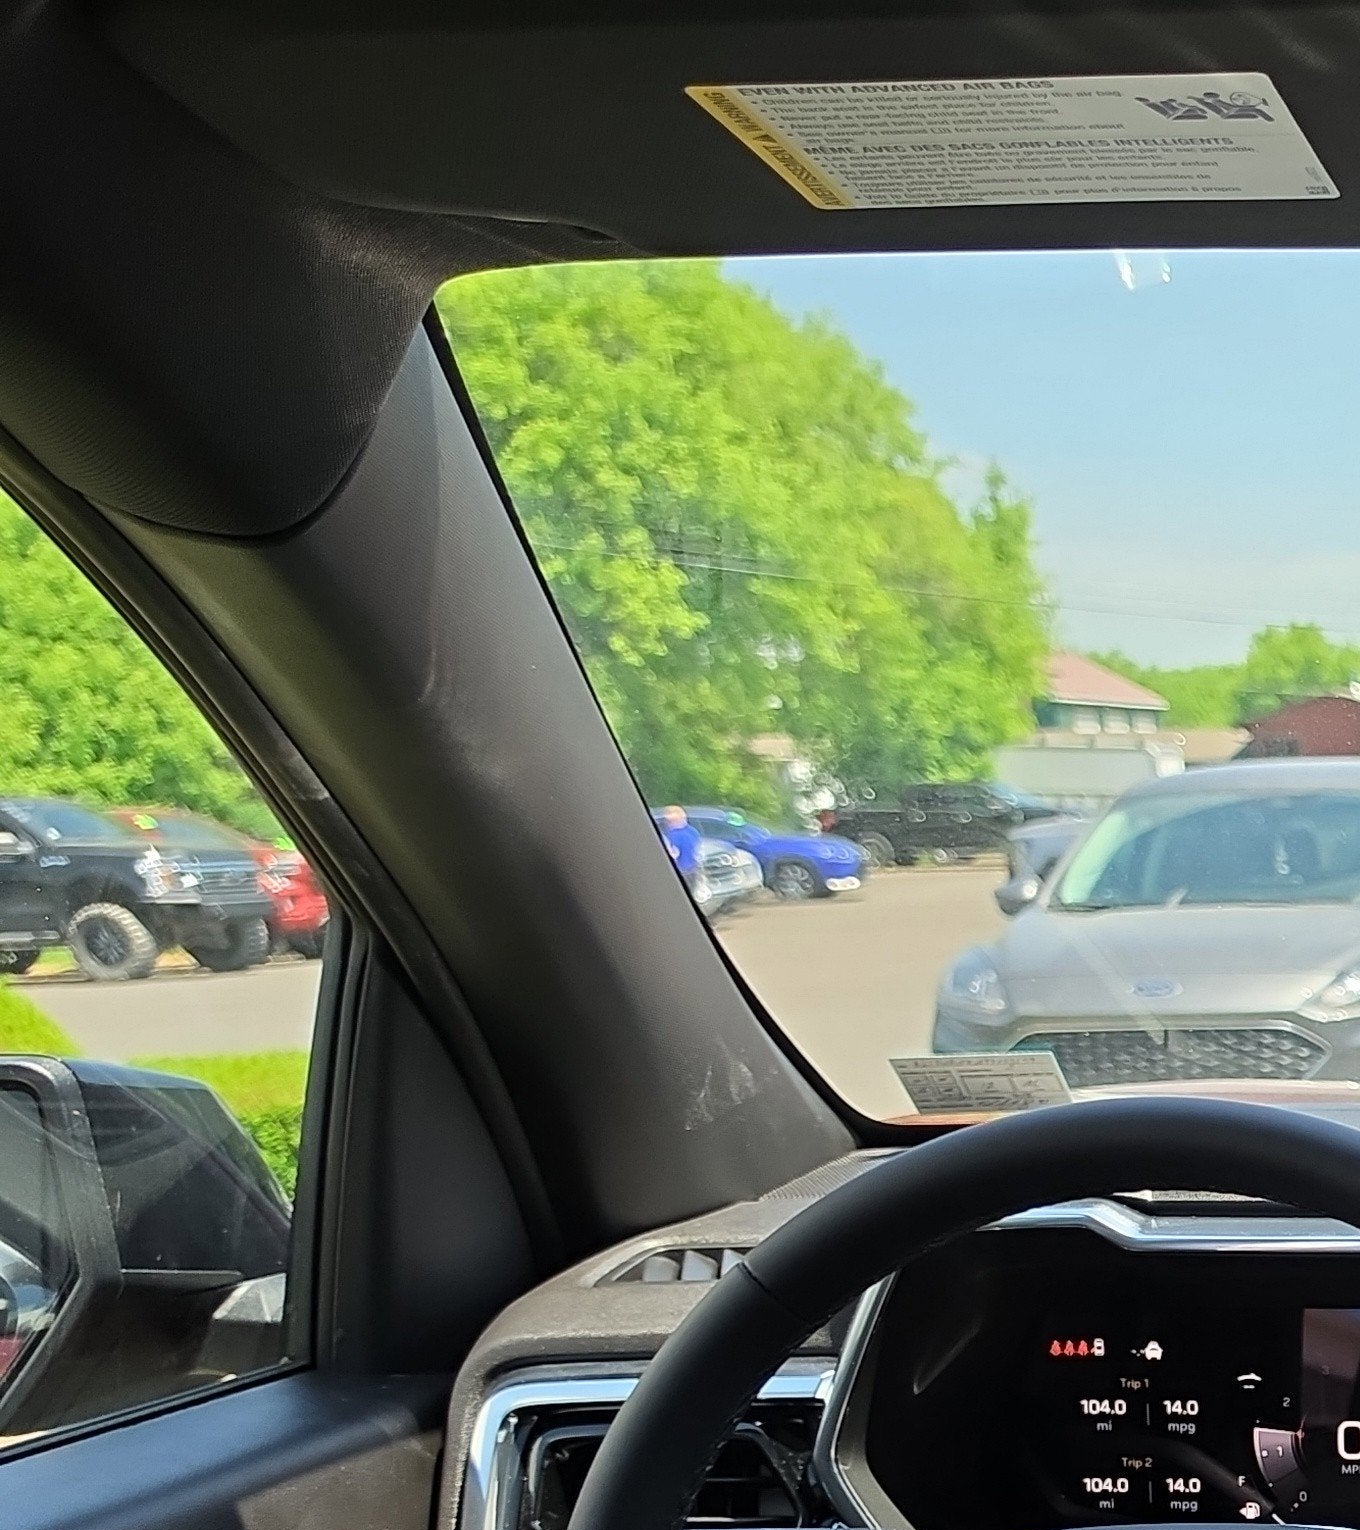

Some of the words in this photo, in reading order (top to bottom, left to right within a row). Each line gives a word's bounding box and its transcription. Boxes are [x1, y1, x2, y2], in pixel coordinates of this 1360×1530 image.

[739, 86, 789, 97] EVEN
[795, 85, 845, 96] WITH
[850, 83, 957, 94] ADVANCED
[961, 81, 997, 92] AIR
[999, 80, 1056, 91] BAGS
[1120, 1378, 1141, 1390] Trip
[1144, 1378, 1149, 1388] 1
[1080, 1399, 1127, 1415] 104.0
[1163, 1400, 1199, 1415] 14.0
[1283, 1397, 1290, 1407] 2
[1097, 1420, 1112, 1431] mi
[1168, 1423, 1196, 1434] mpg
[1276, 1446, 1283, 1457] 1
[1122, 1457, 1143, 1469] Trip
[1145, 1458, 1152, 1467] 2
[1083, 1478, 1128, 1493] 104.0
[1166, 1478, 1200, 1493] 14.0
[1238, 1476, 1246, 1486] F
[1299, 1491, 1307, 1502] 0
[1100, 1499, 1114, 1509] mi
[1170, 1502, 1198, 1512] mpg
